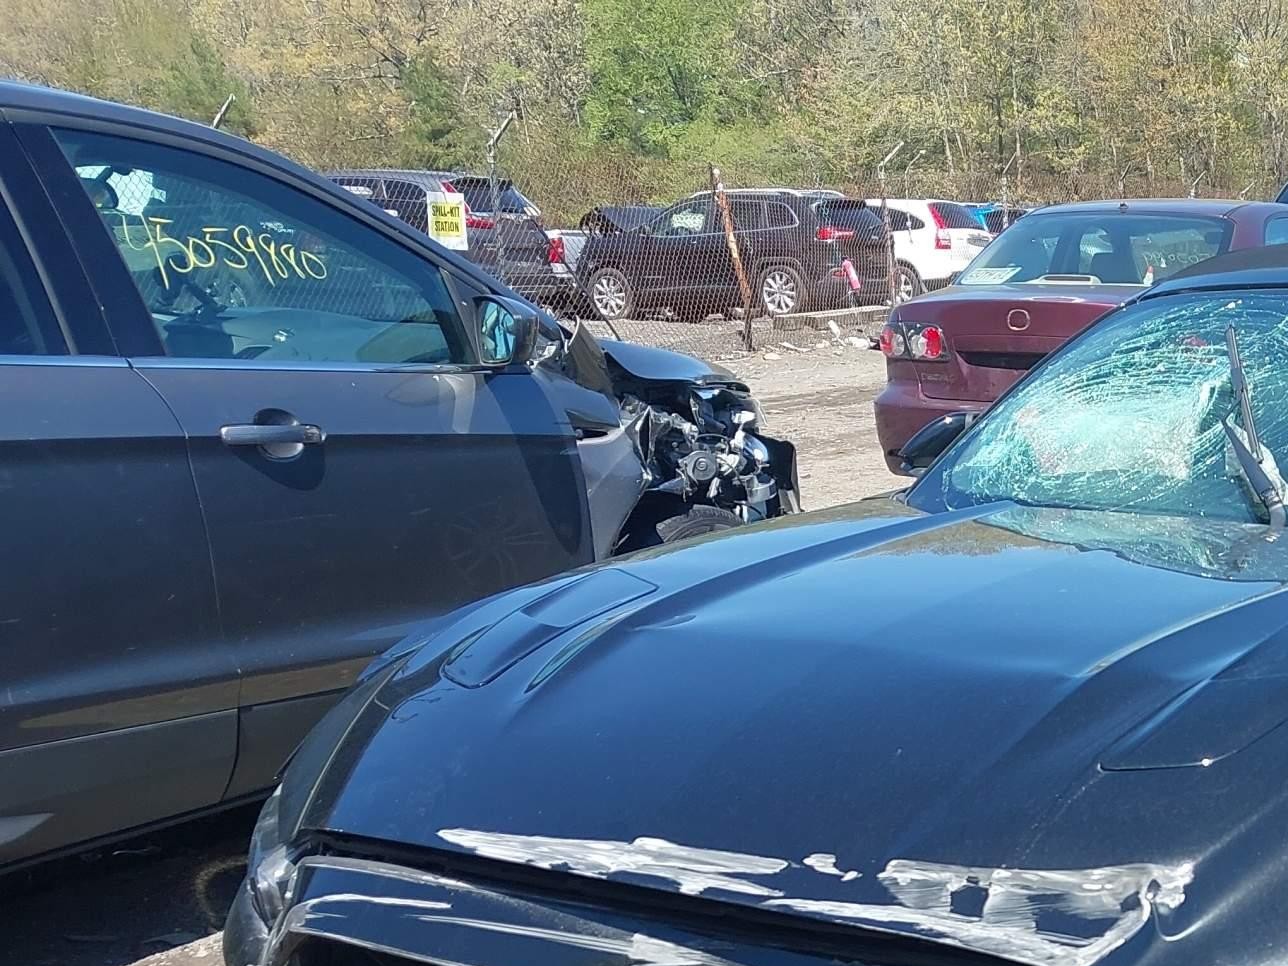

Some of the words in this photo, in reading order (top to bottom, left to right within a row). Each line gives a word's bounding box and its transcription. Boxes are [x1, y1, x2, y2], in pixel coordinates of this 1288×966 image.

[431, 205, 461, 217] SPILL-KIT
[434, 220, 460, 232] STATION
[121, 212, 328, 290] 45059880
